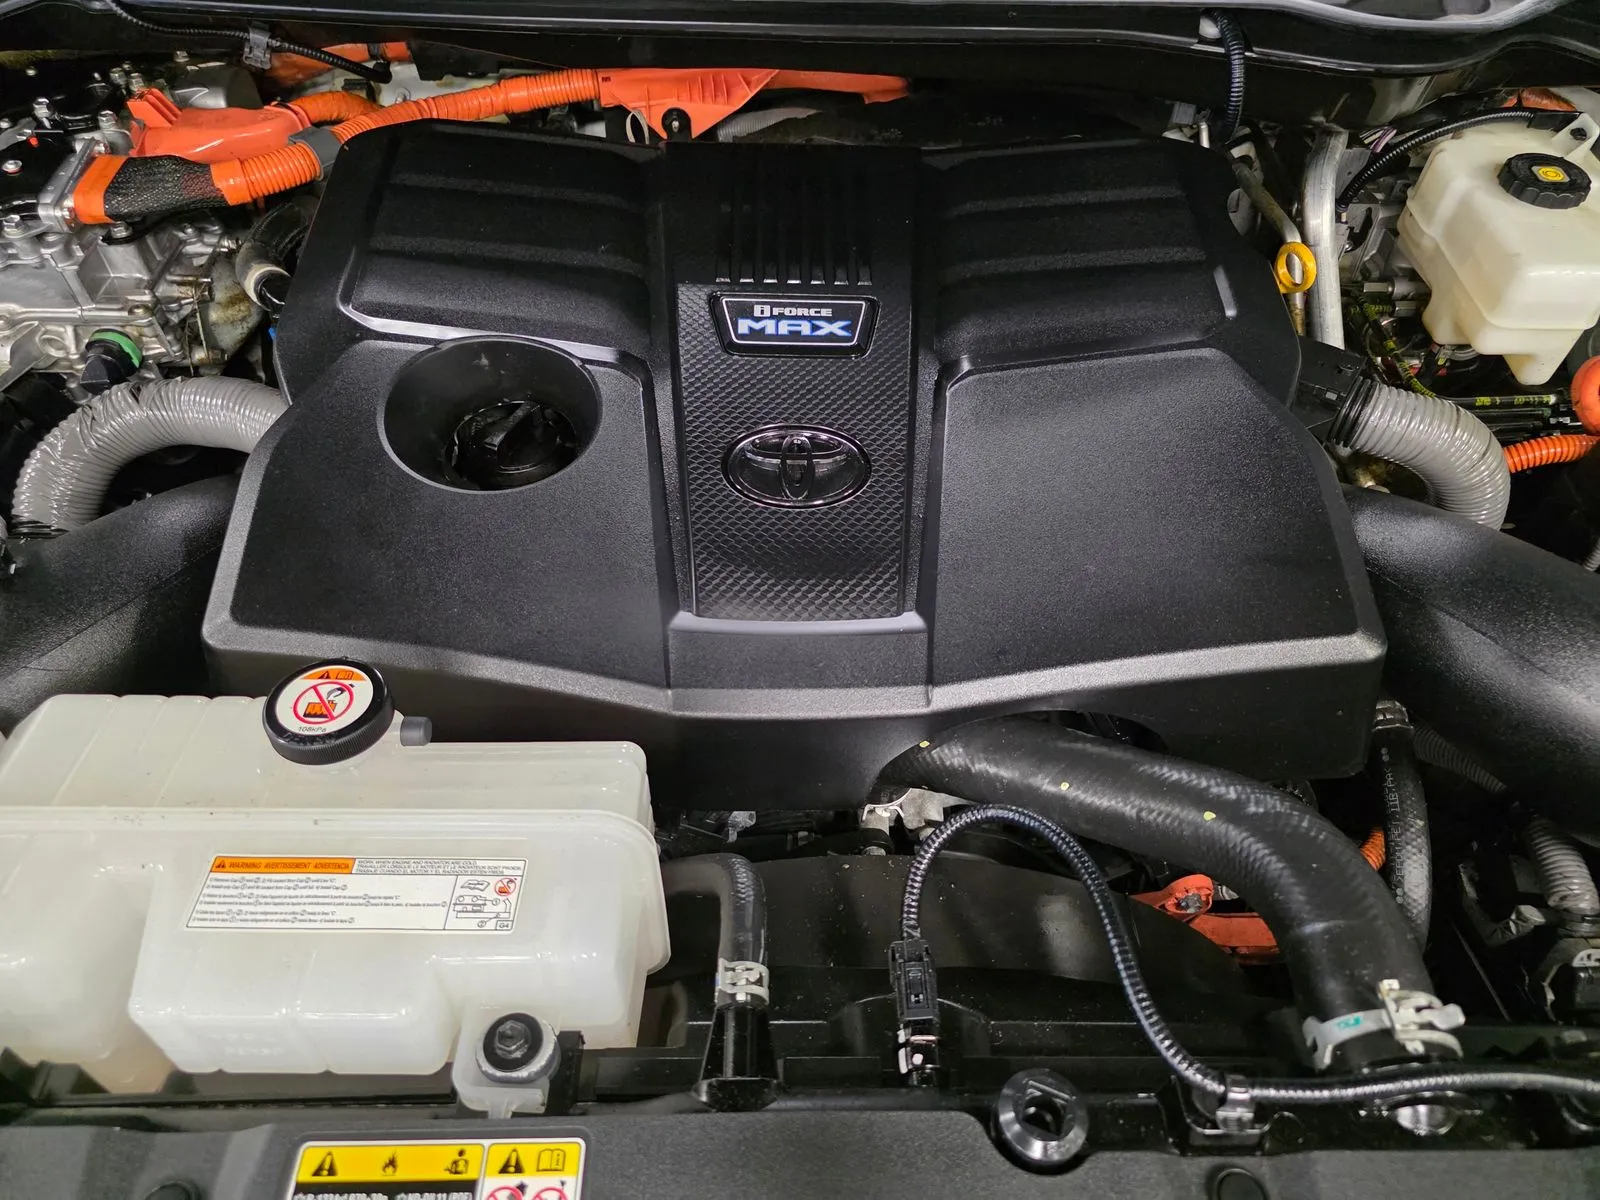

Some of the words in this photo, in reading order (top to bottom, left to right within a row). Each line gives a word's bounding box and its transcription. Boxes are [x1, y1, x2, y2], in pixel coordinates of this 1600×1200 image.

[772, 307, 833, 317] FORCE
[737, 318, 852, 336] MAX
[228, 861, 260, 869] WARNING
